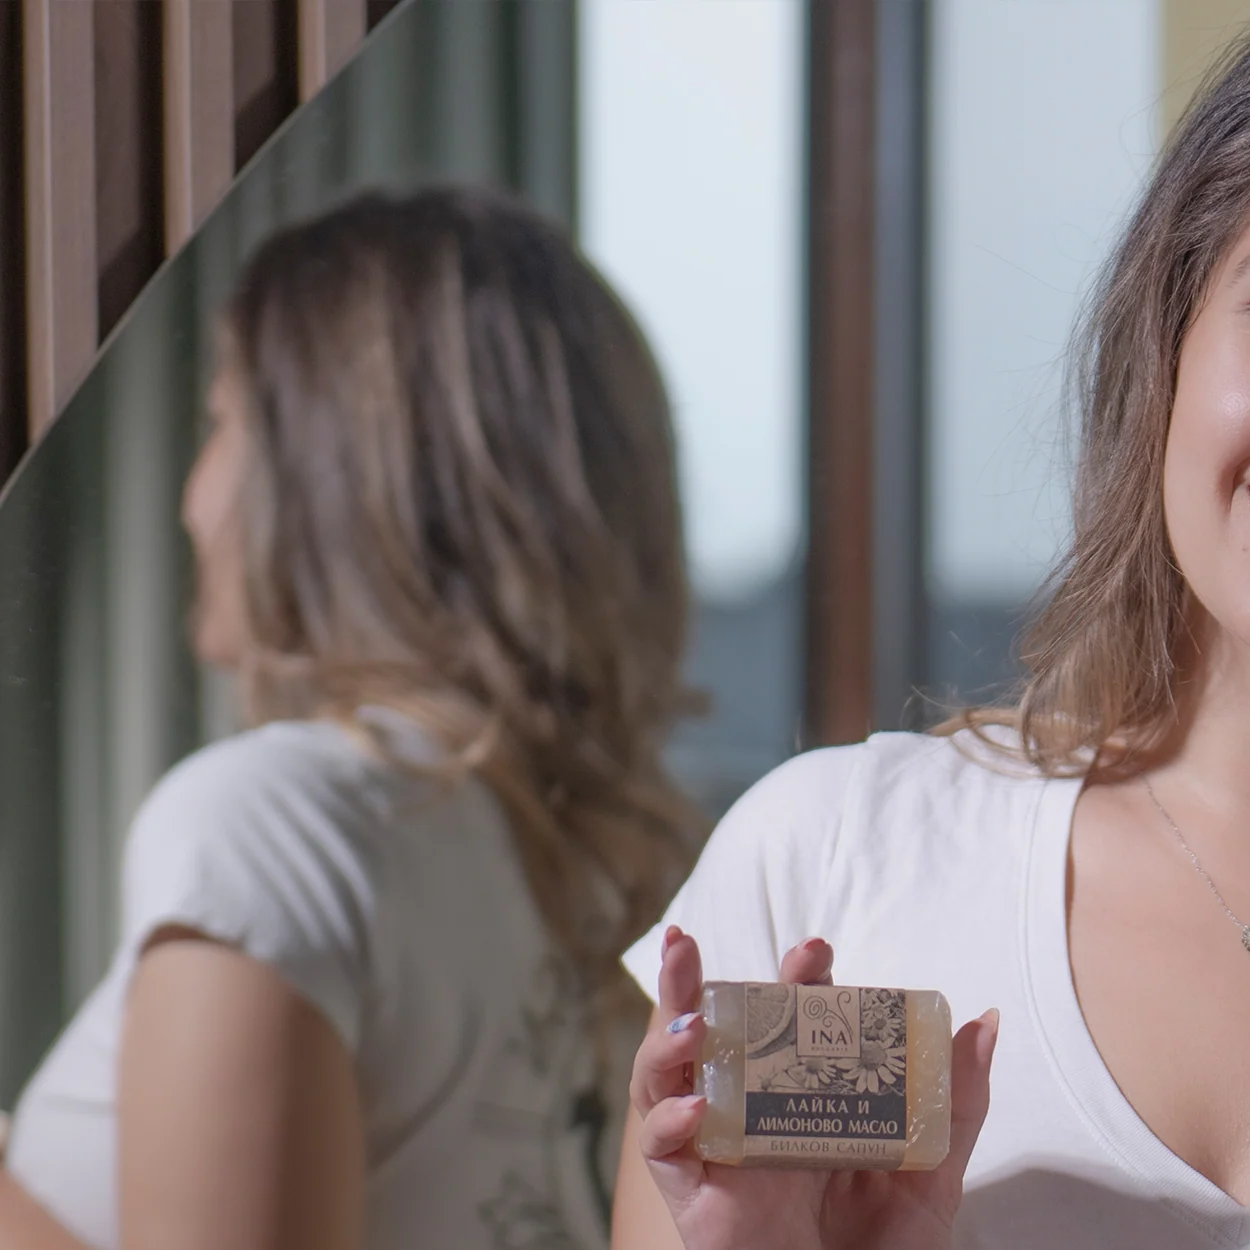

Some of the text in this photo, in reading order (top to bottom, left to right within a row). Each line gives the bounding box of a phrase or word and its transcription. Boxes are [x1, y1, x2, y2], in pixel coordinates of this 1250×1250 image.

[811, 1029, 848, 1045] INA
[785, 1096, 870, 1115] ЛАЙКА И
[756, 1116, 899, 1135] ЛИМОНОВО МАСЛО
[770, 1139, 887, 1155] БИЛКОВ САПУН
